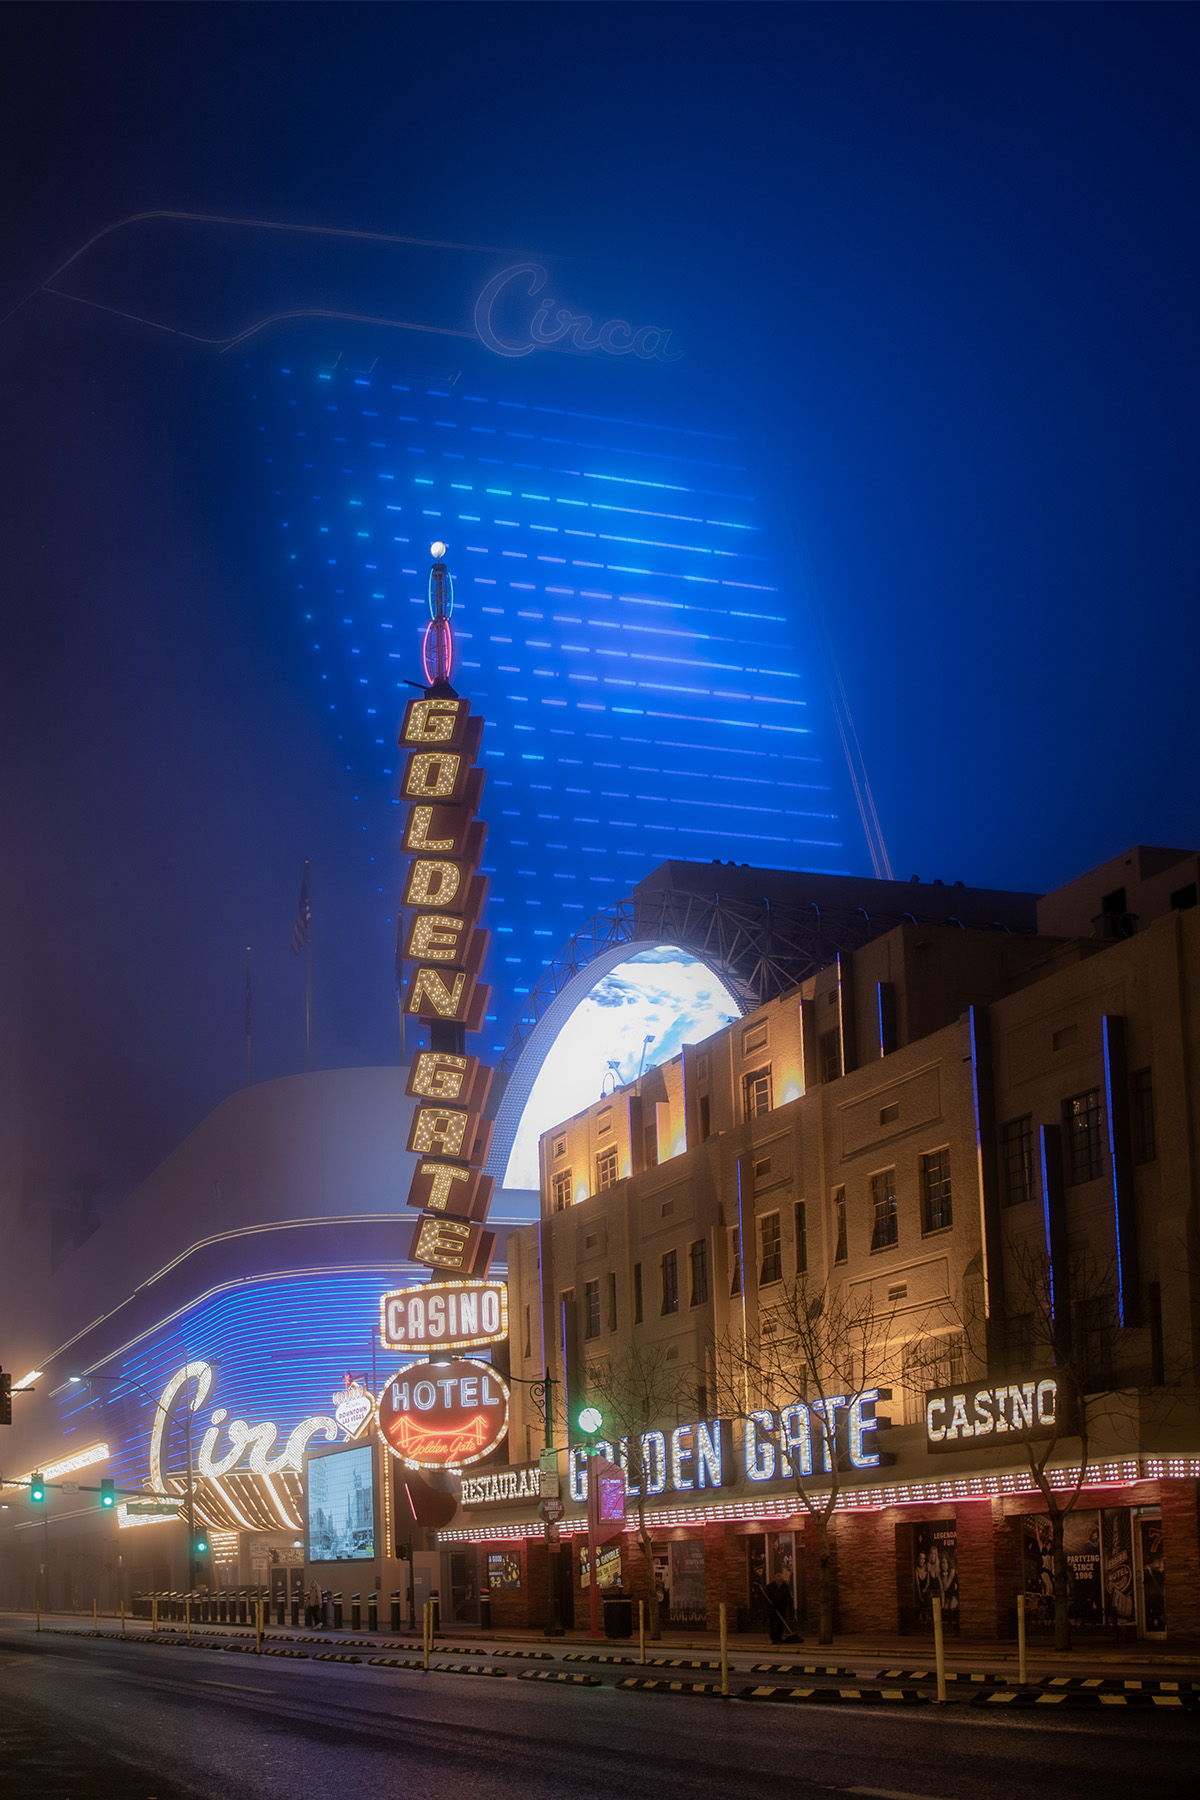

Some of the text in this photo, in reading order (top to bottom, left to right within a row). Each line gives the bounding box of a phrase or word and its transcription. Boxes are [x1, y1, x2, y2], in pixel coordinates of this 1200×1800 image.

[474, 262, 685, 362] Circa
[407, 699, 466, 1018] GOLDEN
[411, 1051, 471, 1266] GATE
[388, 1290, 500, 1341] CASINO
[392, 1375, 499, 1412] HOTEL
[927, 1379, 1058, 1442] CASINO
[151, 1361, 338, 1506] Circ
[408, 1436, 476, 1463] Golden Gate
[744, 1389, 880, 1483] GATE
[461, 1467, 540, 1505] RESTAURAN
[1067, 1554, 1100, 1565] PARTYING
[1073, 1563, 1095, 1571] SINCE
